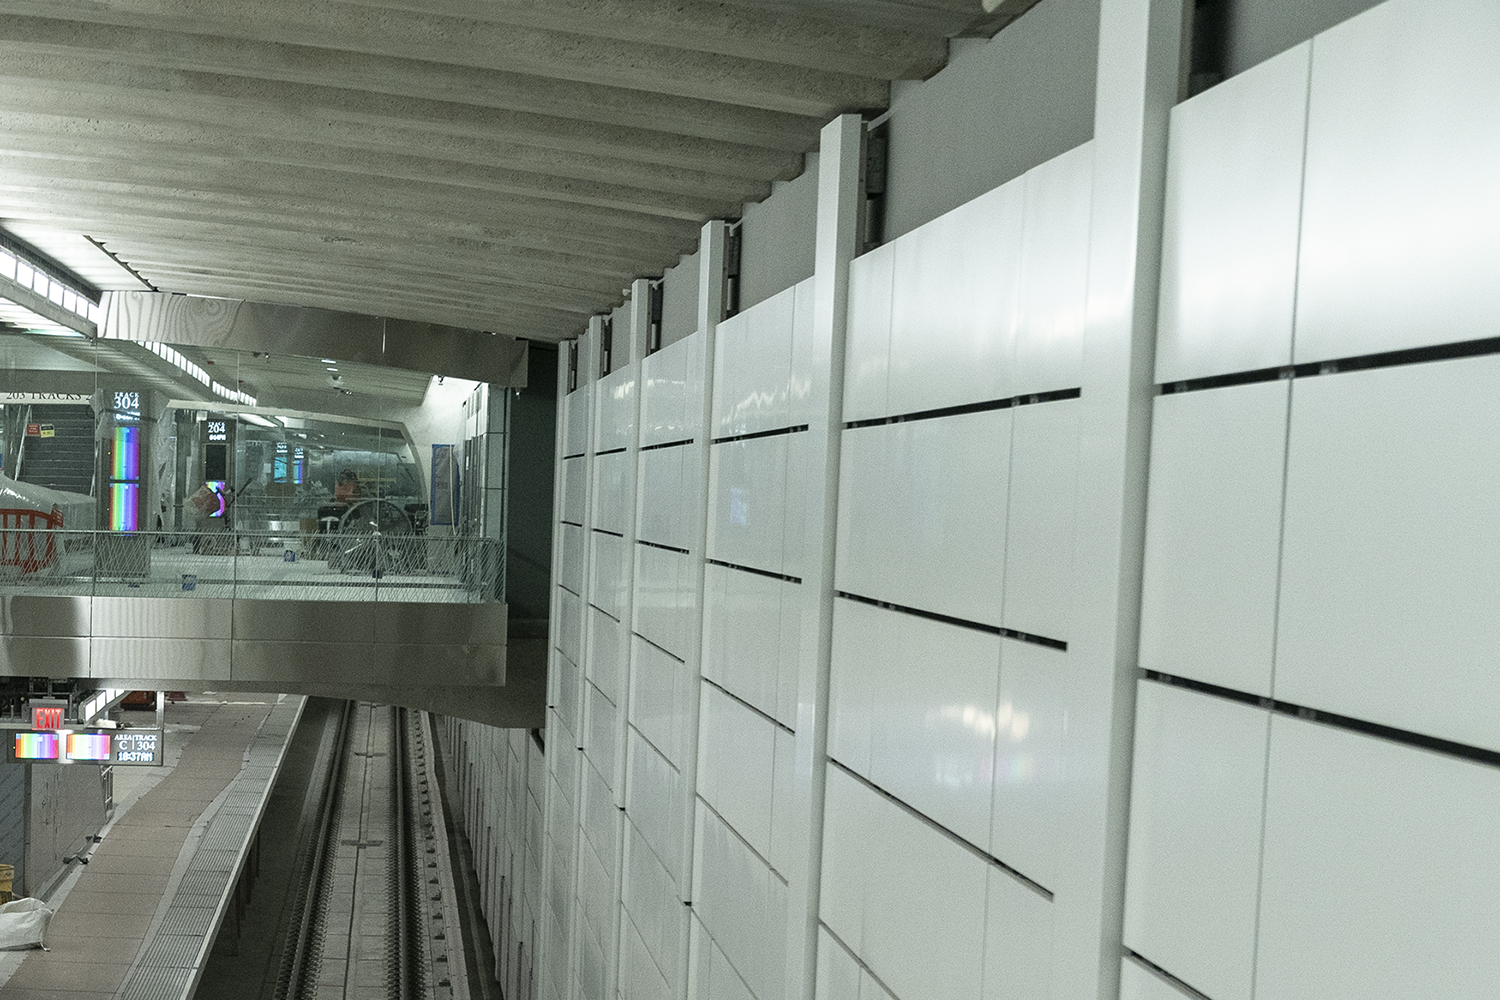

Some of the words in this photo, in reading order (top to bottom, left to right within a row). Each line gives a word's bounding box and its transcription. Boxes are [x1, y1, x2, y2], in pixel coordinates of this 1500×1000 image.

[114, 397, 139, 409] 304
[208, 425, 226, 433] 204
[35, 708, 63, 729] EXIT
[118, 740, 128, 751] C
[136, 740, 156, 751] 304
